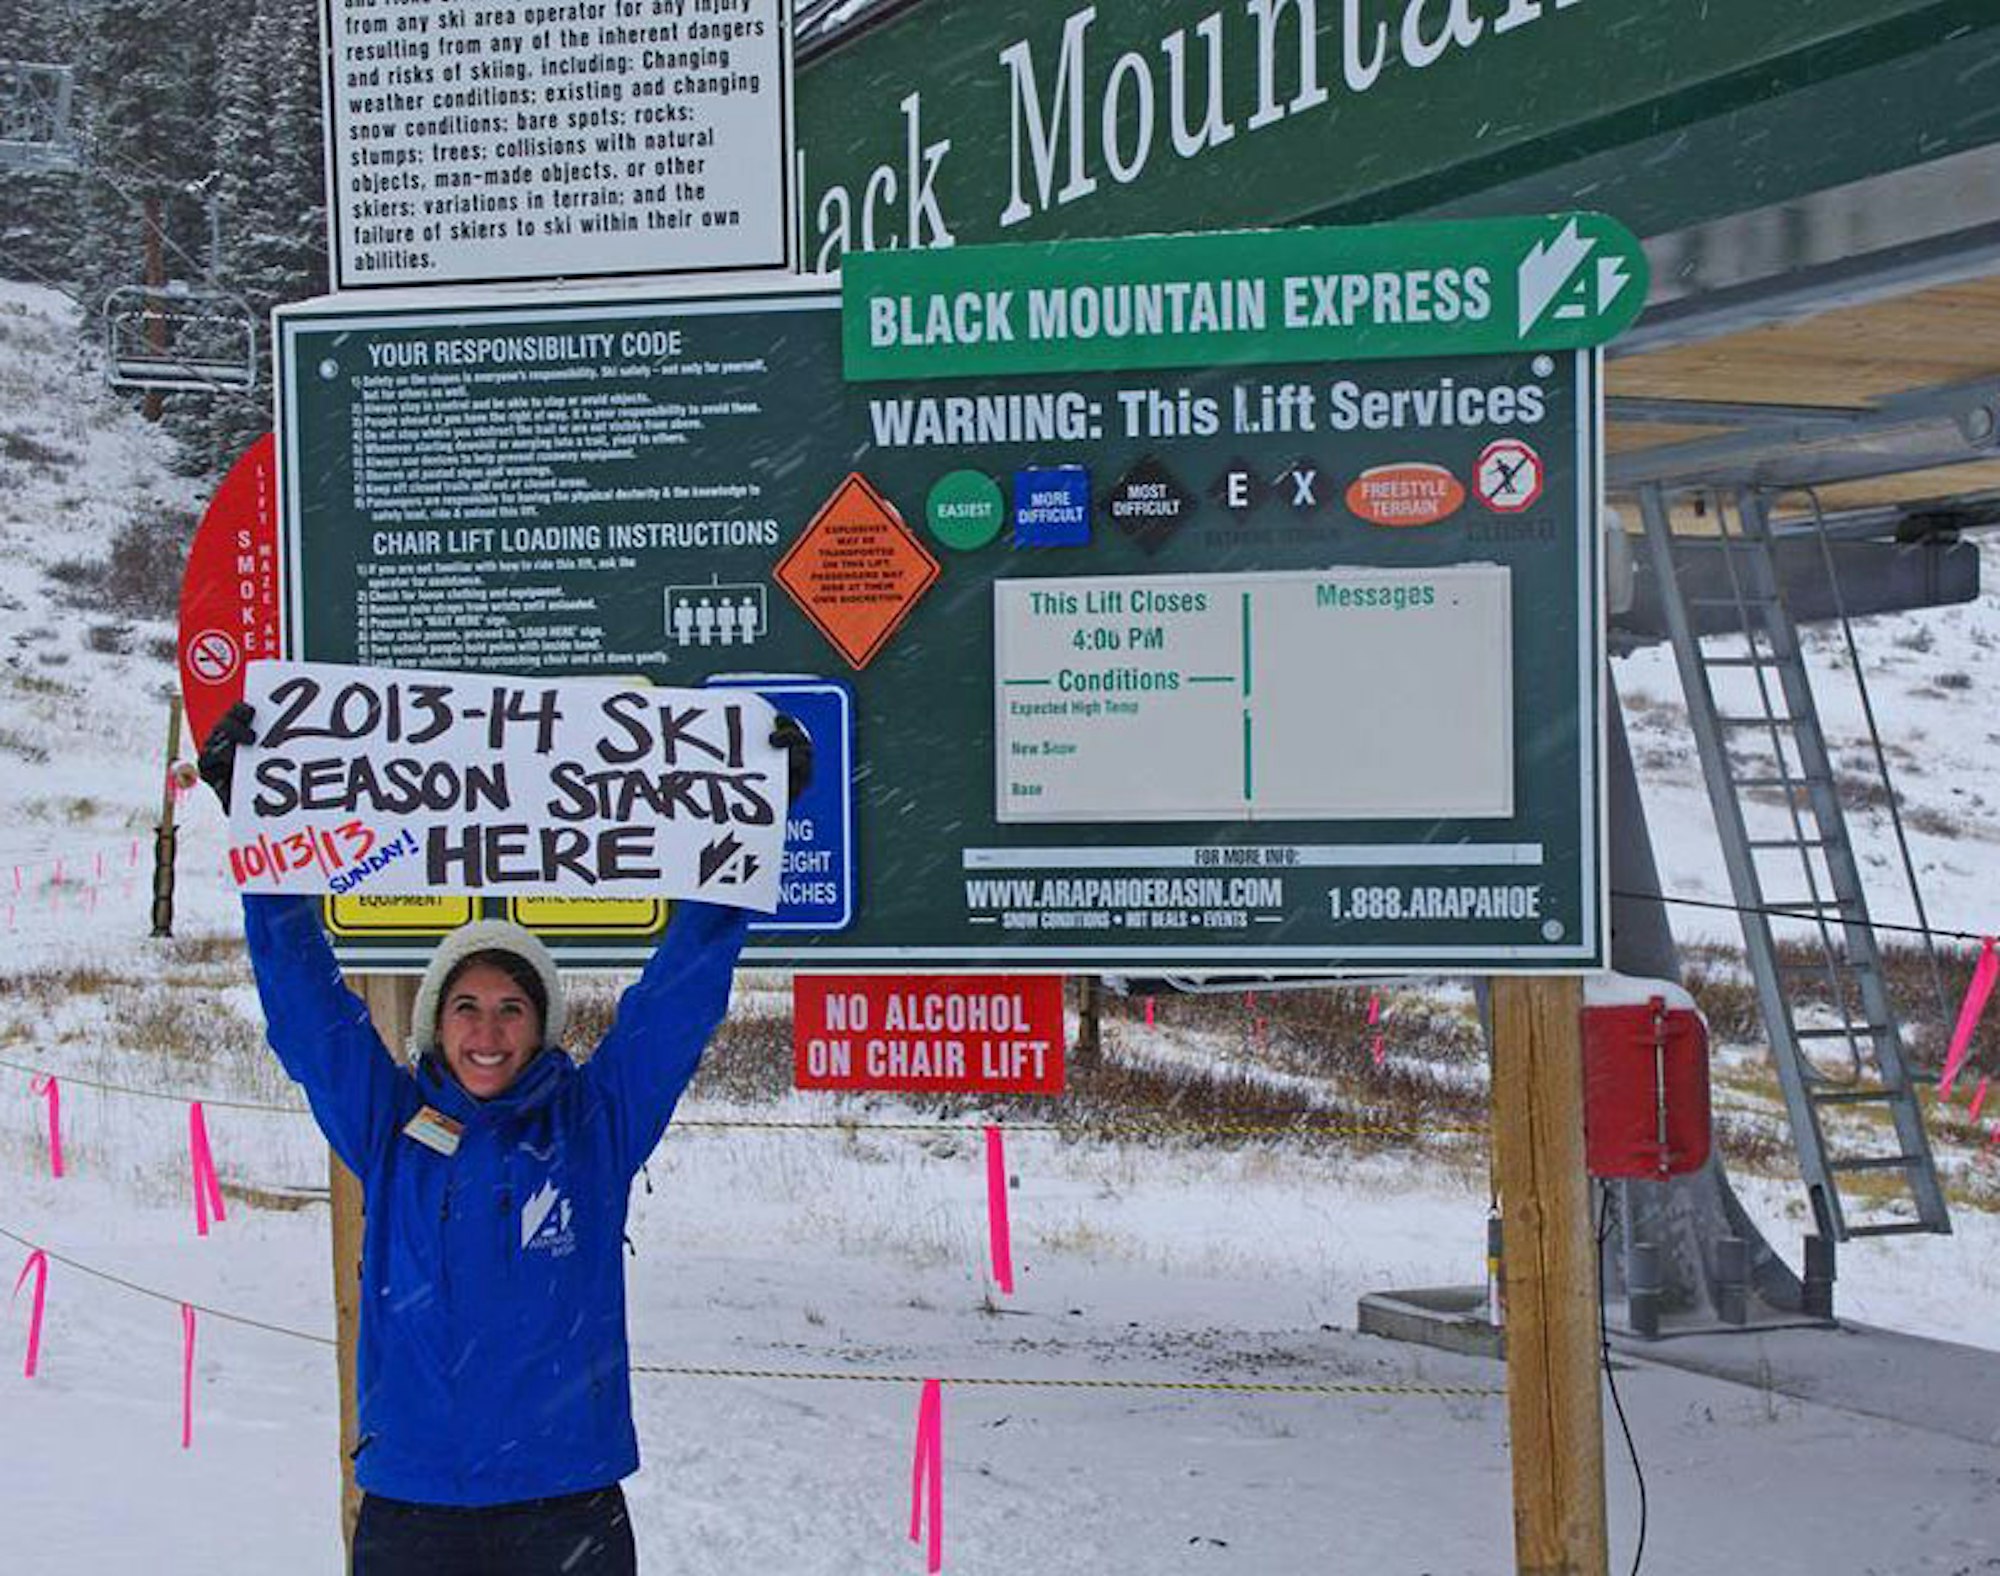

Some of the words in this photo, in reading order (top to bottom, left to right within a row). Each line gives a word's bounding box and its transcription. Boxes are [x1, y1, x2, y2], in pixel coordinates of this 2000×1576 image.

[345, 15, 388, 36] from
[396, 15, 429, 35] any
[438, 8, 466, 31] ski
[474, 8, 516, 28] area
[524, 1, 606, 27] operator
[615, 0, 642, 19] for
[652, 0, 685, 19] any
[346, 38, 430, 62] resulting
[438, 36, 482, 57] from
[490, 35, 523, 56] any
[531, 28, 550, 52] of
[559, 28, 590, 49] the
[598, 21, 678, 46] inherent
[687, 19, 765, 43] dangers
[347, 65, 380, 89] and
[387, 63, 434, 87] risks
[442, 61, 461, 84] of
[642, 45, 730, 72] Changing
[348, 91, 425, 115] weather
[544, 79, 623, 105] existing
[631, 76, 665, 99] and
[673, 70, 760, 97] changing
[349, 122, 397, 142] snow
[516, 110, 558, 132] bare
[495, 135, 587, 160] collisions
[595, 131, 636, 154] with
[644, 126, 714, 152] natural
[434, 163, 533, 189] man-made
[626, 161, 646, 179] or
[654, 155, 705, 178] other
[423, 192, 518, 216] variations
[527, 190, 544, 210] in
[633, 182, 666, 205] and
[675, 181, 705, 203] the
[353, 225, 414, 245] failure
[422, 221, 442, 242] of
[450, 219, 508, 241] skiers
[516, 216, 535, 238] to
[544, 214, 572, 237] ski
[580, 211, 639, 235] within
[647, 207, 693, 230] their
[701, 209, 740, 228] own
[354, 250, 437, 273] abilities.
[870, 291, 1013, 348] BLACK
[1028, 278, 1265, 340] MOUNTAIN
[1283, 266, 1491, 330] EXPRESS
[368, 342, 429, 368] YOUR
[433, 333, 614, 366] RESPONSIBILITY
[621, 330, 682, 357] CODE
[870, 392, 1102, 448] WARNING:
[1117, 386, 1219, 438] This
[1234, 383, 1316, 436] Lift
[1330, 378, 1546, 432] Services
[1030, 491, 1072, 507] MORE
[1127, 484, 1167, 500] MOST
[1227, 472, 1249, 507] E
[1292, 470, 1317, 506] X
[1360, 479, 1448, 499] FREESTYLE
[937, 502, 993, 519] EASIEST
[1018, 506, 1085, 524] DIFFICULT
[1111, 499, 1181, 517] DIFFICULT
[1371, 500, 1439, 518] TERRAIN
[372, 528, 441, 556] CHAIR
[448, 527, 494, 554] LIFT
[501, 524, 600, 553] LOADING
[608, 518, 779, 549] INSTRUCTIONS
[236, 530, 256, 651] SMOKE
[1029, 591, 1078, 615] This
[1085, 590, 1123, 614] Lift
[1130, 589, 1208, 614] Closes
[1315, 581, 1435, 611] Messages
[1072, 627, 1120, 651] 4:00
[1129, 626, 1164, 650] PM
[1058, 667, 1180, 692] Conditions
[259, 676, 563, 755] 2013-14
[596, 691, 744, 768] SKI
[1010, 700, 1068, 717] Expected
[1071, 700, 1101, 717] High
[1105, 699, 1139, 715] Temp
[1011, 740, 1039, 755] New
[1042, 741, 1077, 755] Snow
[253, 755, 511, 818] SEASON
[547, 761, 775, 826] STARTS
[1011, 782, 1042, 796] Base
[228, 819, 376, 886] 10/13/13
[328, 828, 419, 895] SUNDAY!
[426, 824, 661, 888] HERE
[1194, 849, 1219, 866] FOR
[1223, 849, 1262, 865] MORE
[965, 877, 1282, 908] WWW.ARAPAHOEBASIN.COM
[1327, 886, 1541, 920] 1.888.ARAPAHOE
[1002, 911, 1038, 929] SNOW
[1041, 910, 1110, 928] CONDITIONS
[1203, 909, 1248, 927] EVENTS
[825, 993, 869, 1031] NO
[885, 993, 1031, 1032] ALCOHOL
[807, 1039, 850, 1078] ON
[867, 1038, 966, 1078] CHAIR
[981, 1040, 1050, 1079] LIFT
